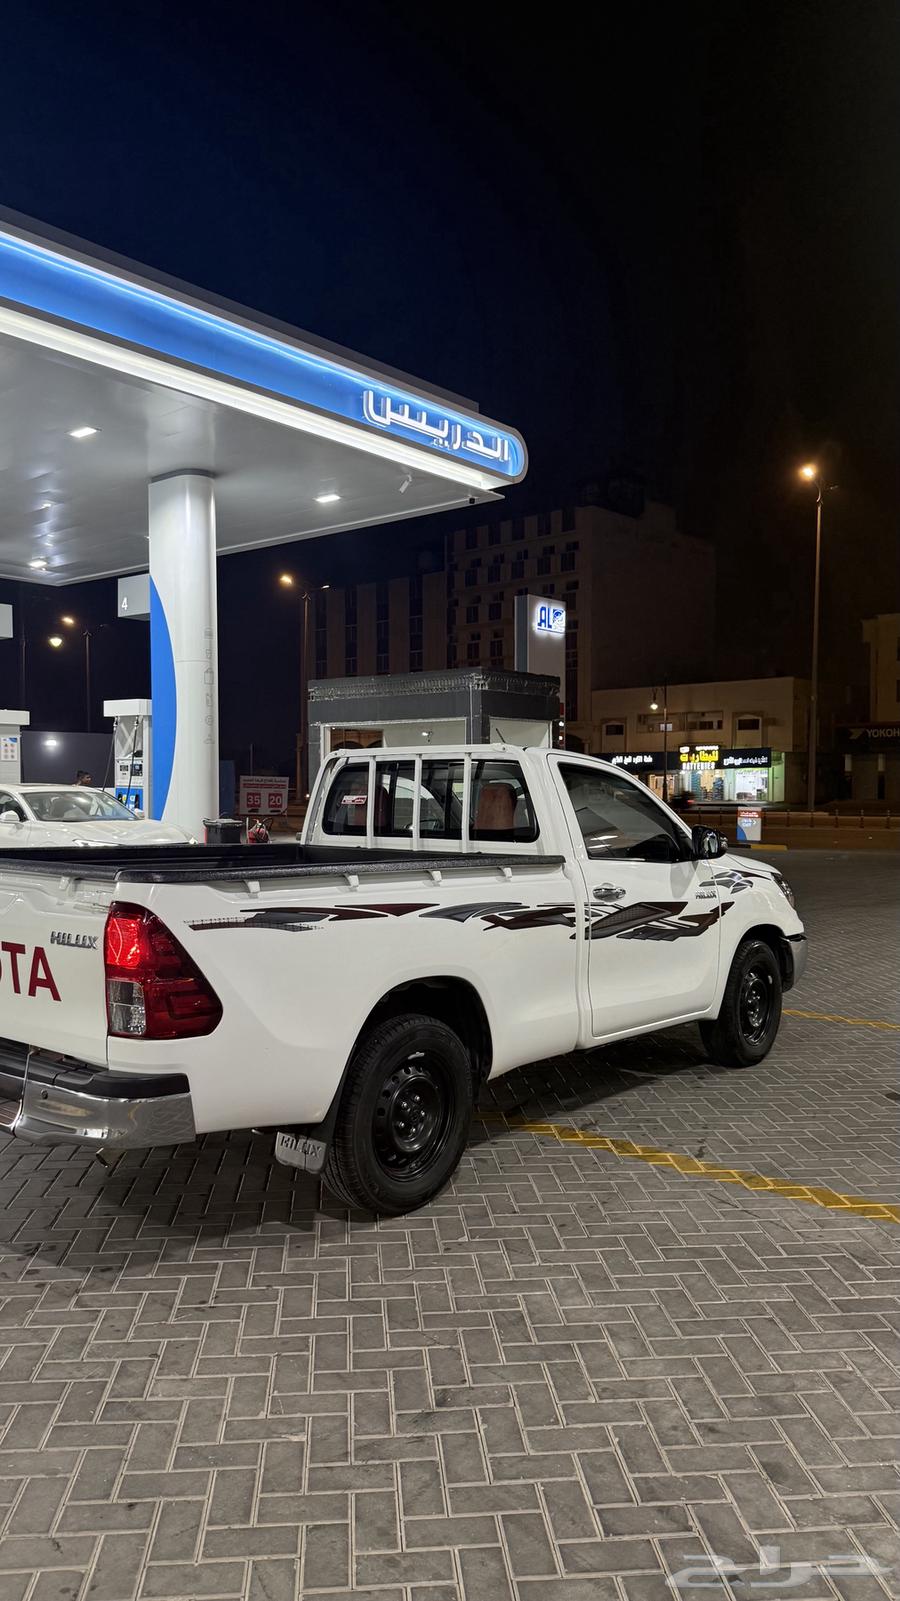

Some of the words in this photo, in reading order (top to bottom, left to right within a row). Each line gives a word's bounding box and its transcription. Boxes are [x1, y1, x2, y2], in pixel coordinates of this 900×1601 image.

[363, 390, 510, 462] الدريس
[121, 597, 128, 610] 4
[866, 728, 900, 738] YOKOH
[682, 762, 716, 770] BATTERIES
[269, 796, 281, 805] 20
[50, 931, 98, 950] HILUX
[0, 941, 62, 1002] TA
[281, 1135, 322, 1159] HILUX
